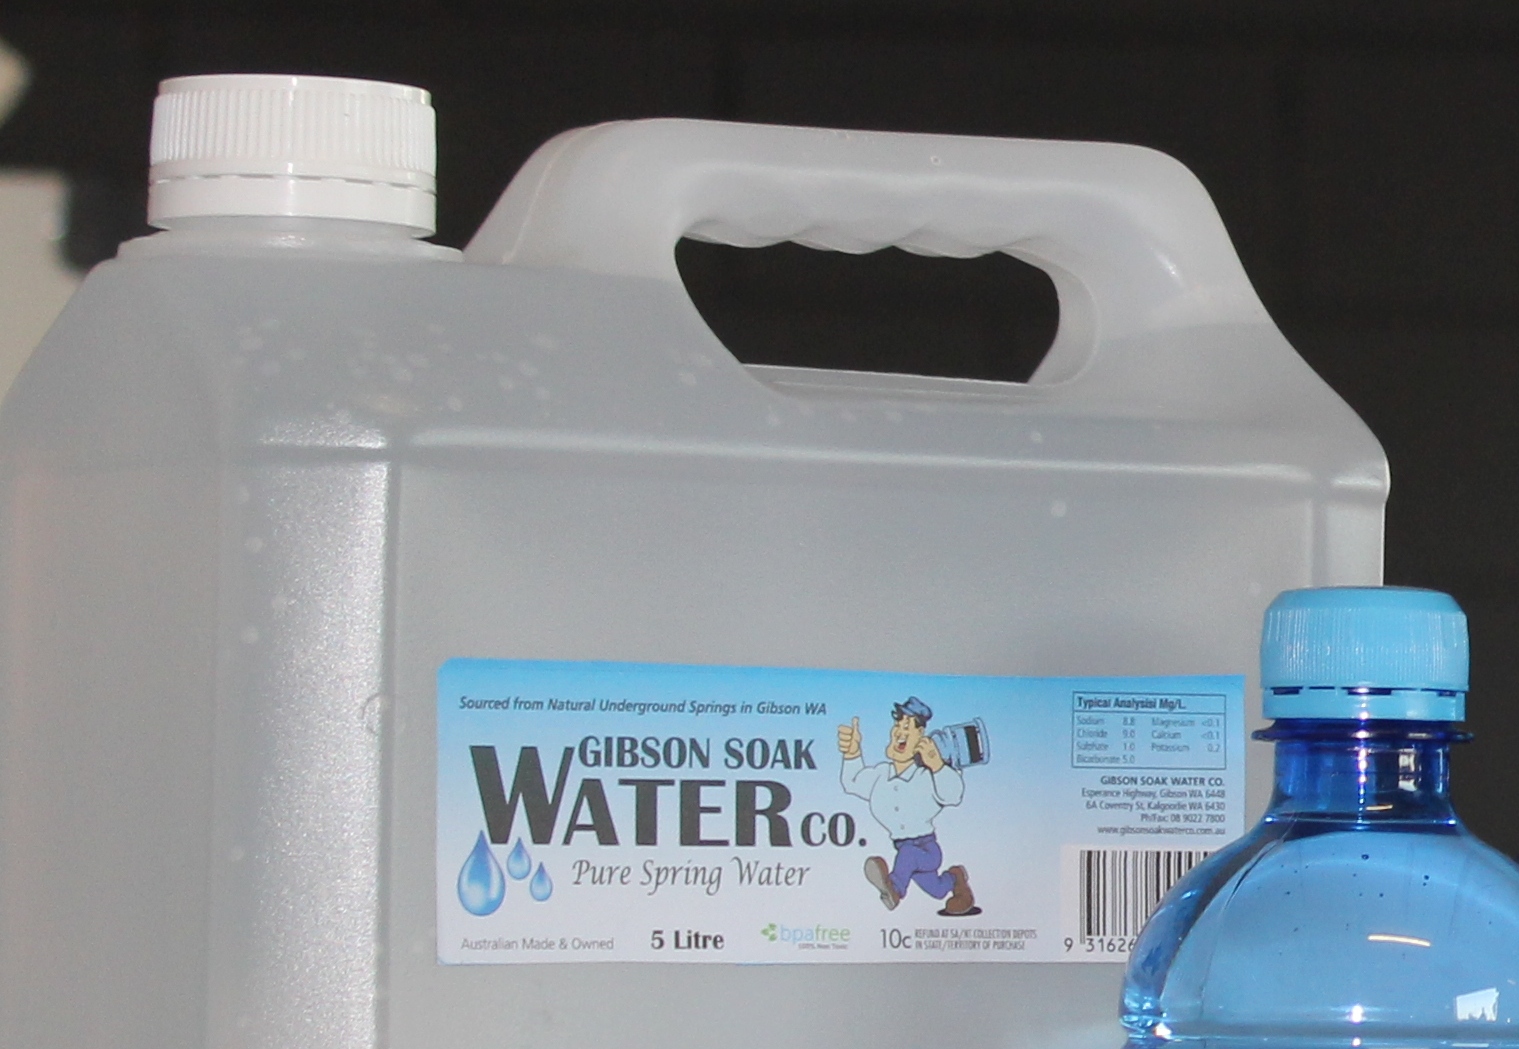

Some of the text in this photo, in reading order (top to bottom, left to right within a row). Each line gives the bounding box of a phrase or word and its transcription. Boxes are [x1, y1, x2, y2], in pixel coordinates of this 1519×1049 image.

[459, 696, 827, 716] Sourced from Natural Underground Springs in Gibson WA
[578, 736, 817, 770] GIBSON SOAK
[1100, 776, 1225, 786] GIBSON SOAK WATER CO.
[470, 745, 867, 847] WATER CO.
[1082, 788, 1121, 799] Esperance
[1160, 789, 1187, 798] Gibson
[1189, 789, 1203, 798] WA
[572, 857, 810, 895] Pure Spring Water
[461, 938, 614, 950] Australian Made & Owned
[651, 930, 725, 949] 5 Litre
[781, 924, 850, 944] bpafree
[881, 928, 911, 949] 10c
[1064, 938, 1074, 952] 9
